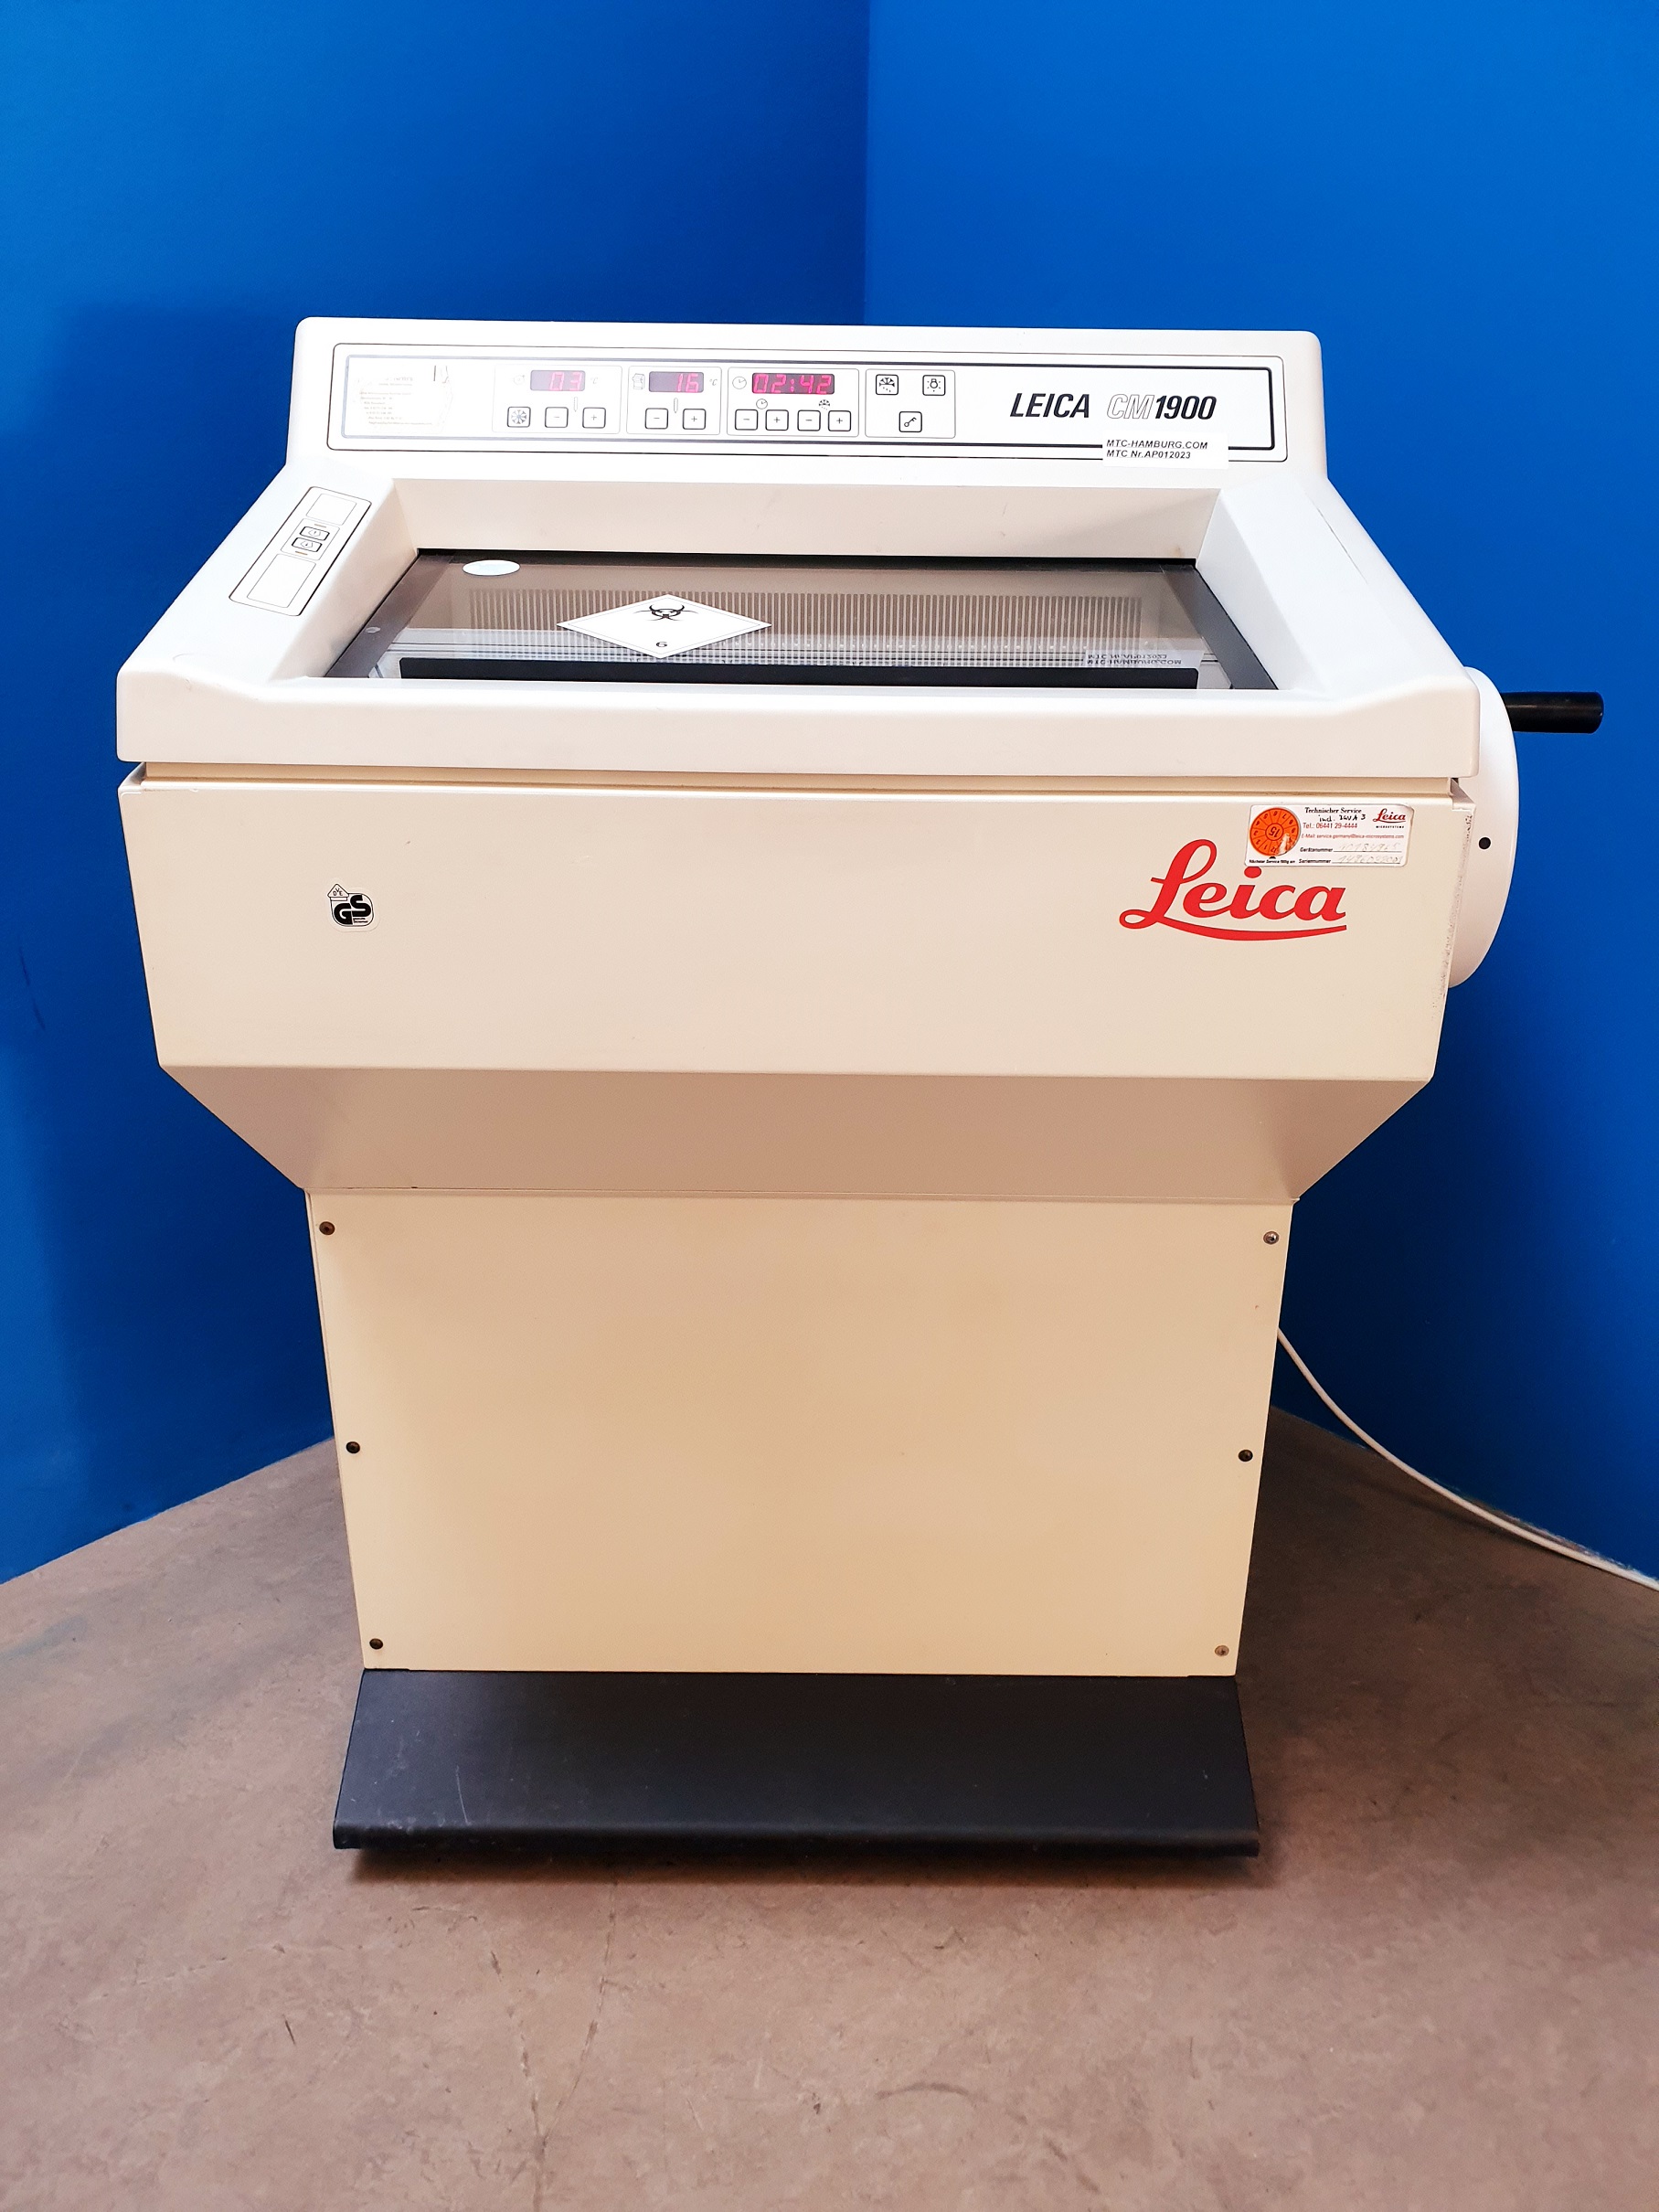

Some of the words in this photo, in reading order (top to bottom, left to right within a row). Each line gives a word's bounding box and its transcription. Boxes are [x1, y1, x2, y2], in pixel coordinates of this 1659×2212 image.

[549, 372, 582, 391] 03
[676, 373, 699, 393] 16
[754, 374, 832, 394] 02:42
[1010, 392, 1090, 419] LEICA
[1106, 393, 1218, 420] CM1900
[1106, 440, 1208, 450] MTC-HAMBURG.COM
[1106, 450, 1128, 458] MTC
[1131, 451, 1191, 459] Nr.AP012023
[1372, 808, 1407, 824] Leica
[1269, 825, 1281, 838] 15
[1119, 839, 1347, 941] Leica
[334, 895, 372, 925] GS
